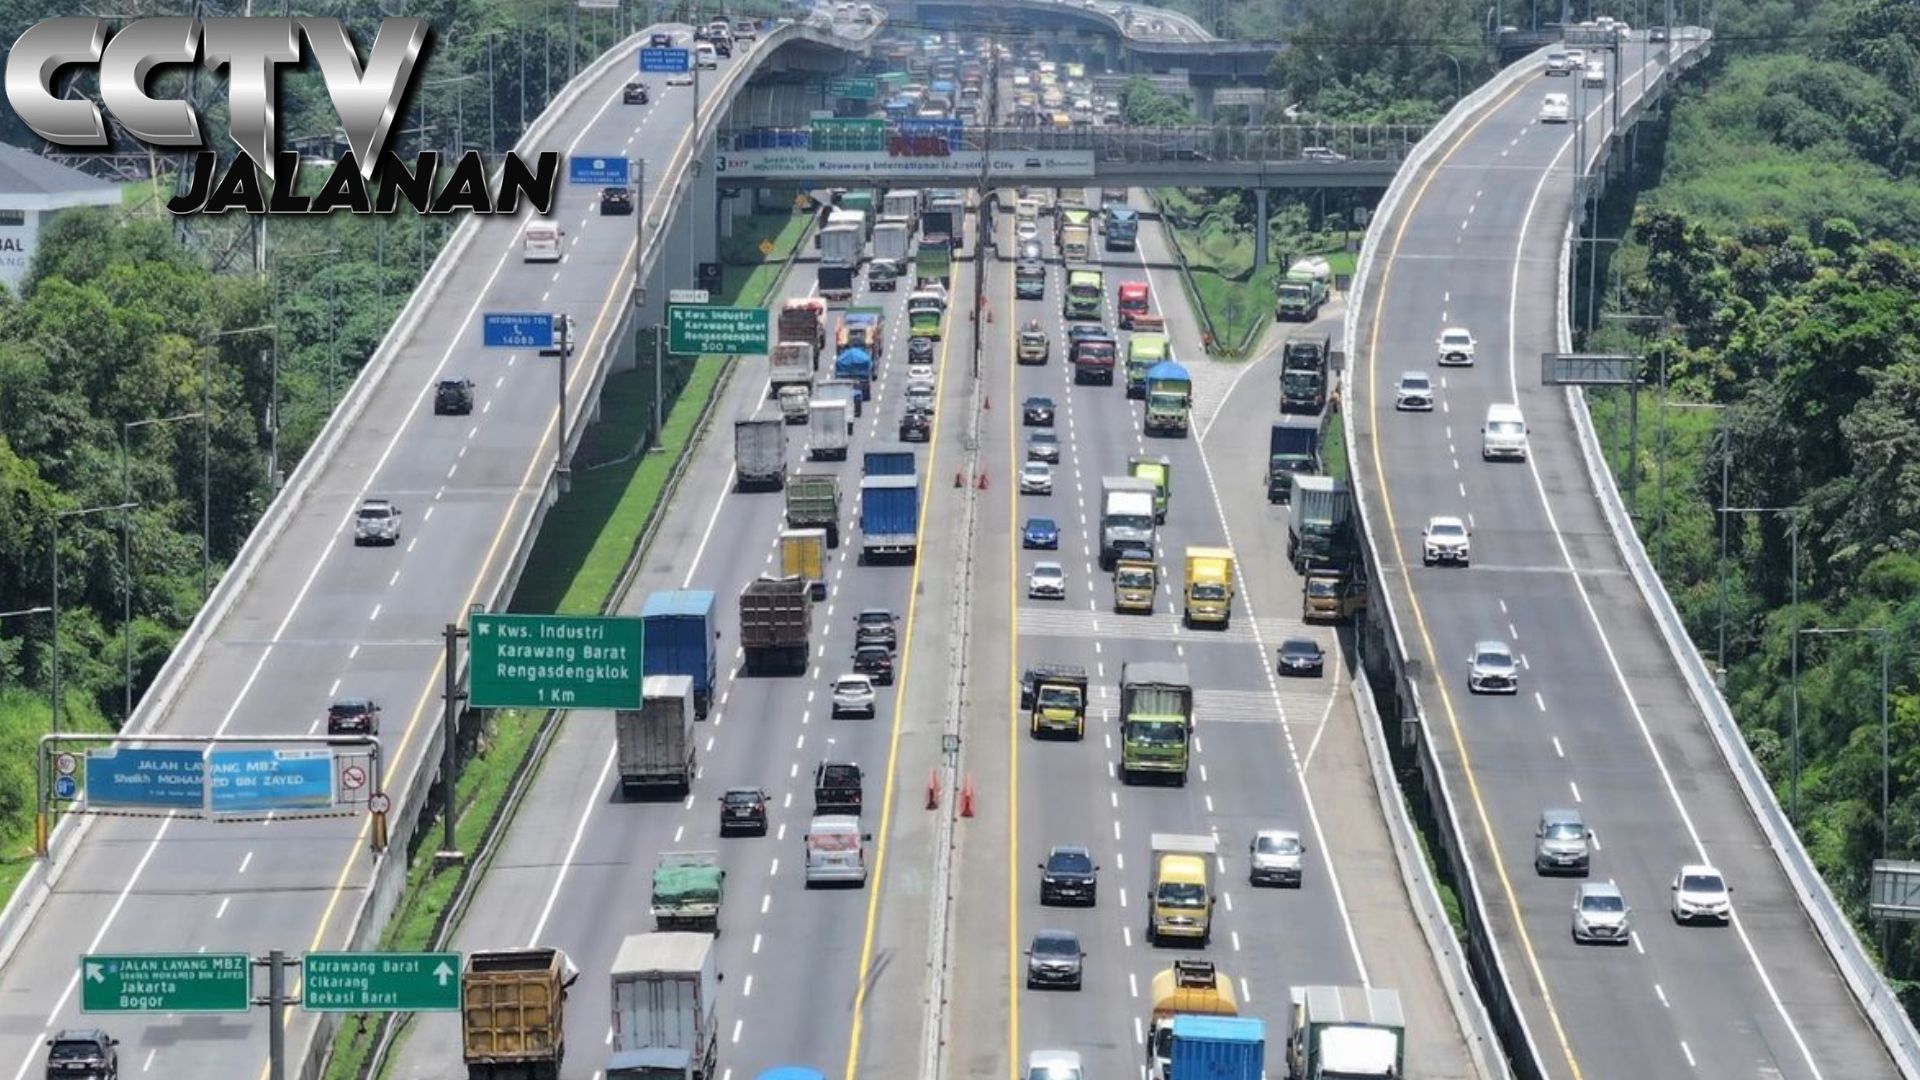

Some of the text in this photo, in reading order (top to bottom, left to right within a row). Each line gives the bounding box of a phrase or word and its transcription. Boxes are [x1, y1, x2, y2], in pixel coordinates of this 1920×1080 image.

[684, 310, 753, 320] Kws. Industri
[684, 321, 766, 333] Karawang Barat
[701, 342, 724, 351] 500
[498, 624, 604, 639] Kws. Industri
[498, 644, 626, 661] Karawang Barat
[497, 663, 629, 682] Rengasdengklok
[538, 688, 575, 702] 1 Km
[137, 760, 178, 771] JALAN
[246, 761, 281, 772] MBZ
[113, 773, 151, 784] Sheikh
[236, 776, 257, 786] BIN
[263, 775, 304, 786] ZAYED
[120, 958, 242, 971] JALAN LAYANG MBZ
[310, 960, 419, 974] Karawang Barat
[121, 981, 176, 994] Jakarta
[310, 976, 369, 990] Cikarang
[120, 995, 164, 1010] Bogor
[310, 992, 398, 1004] Bekasi Barat
